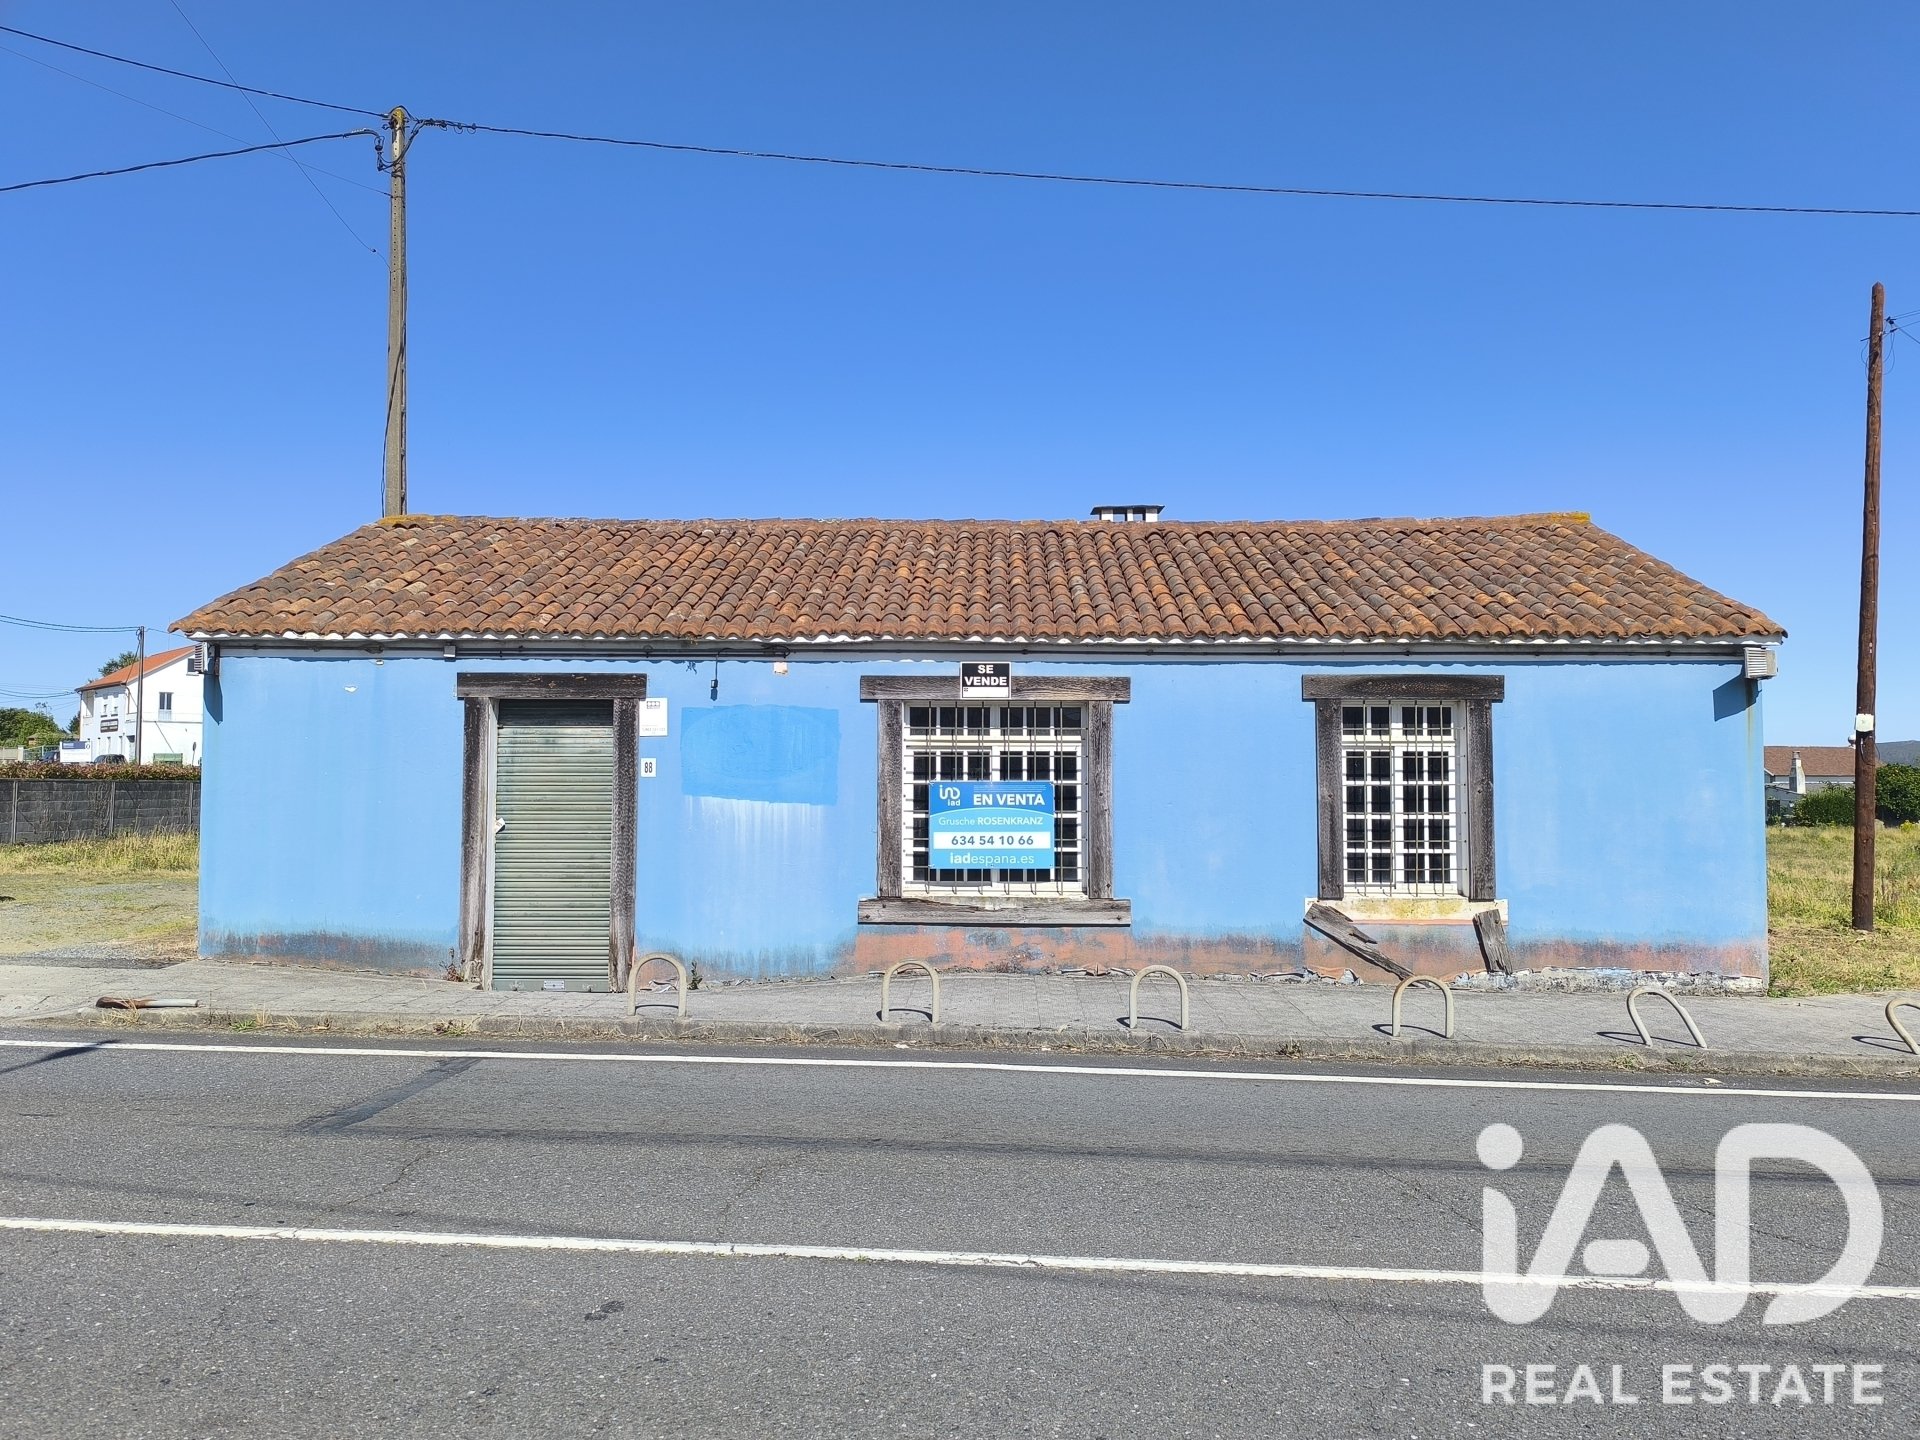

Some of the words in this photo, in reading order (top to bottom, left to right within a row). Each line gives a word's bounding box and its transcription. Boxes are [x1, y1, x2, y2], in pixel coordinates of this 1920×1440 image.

[977, 664, 994, 674] SE
[964, 676, 1008, 686] VENDE
[644, 761, 653, 773] 88
[973, 793, 993, 805] EN
[996, 793, 1045, 805] VENTA
[938, 816, 976, 826] Grusche
[977, 816, 1043, 825] ROSENKRANZ
[951, 835, 975, 846] 634
[979, 835, 994, 846] 54
[999, 835, 1014, 846] 10
[1018, 835, 1034, 846] 66
[950, 852, 1035, 866] iadespana.es
